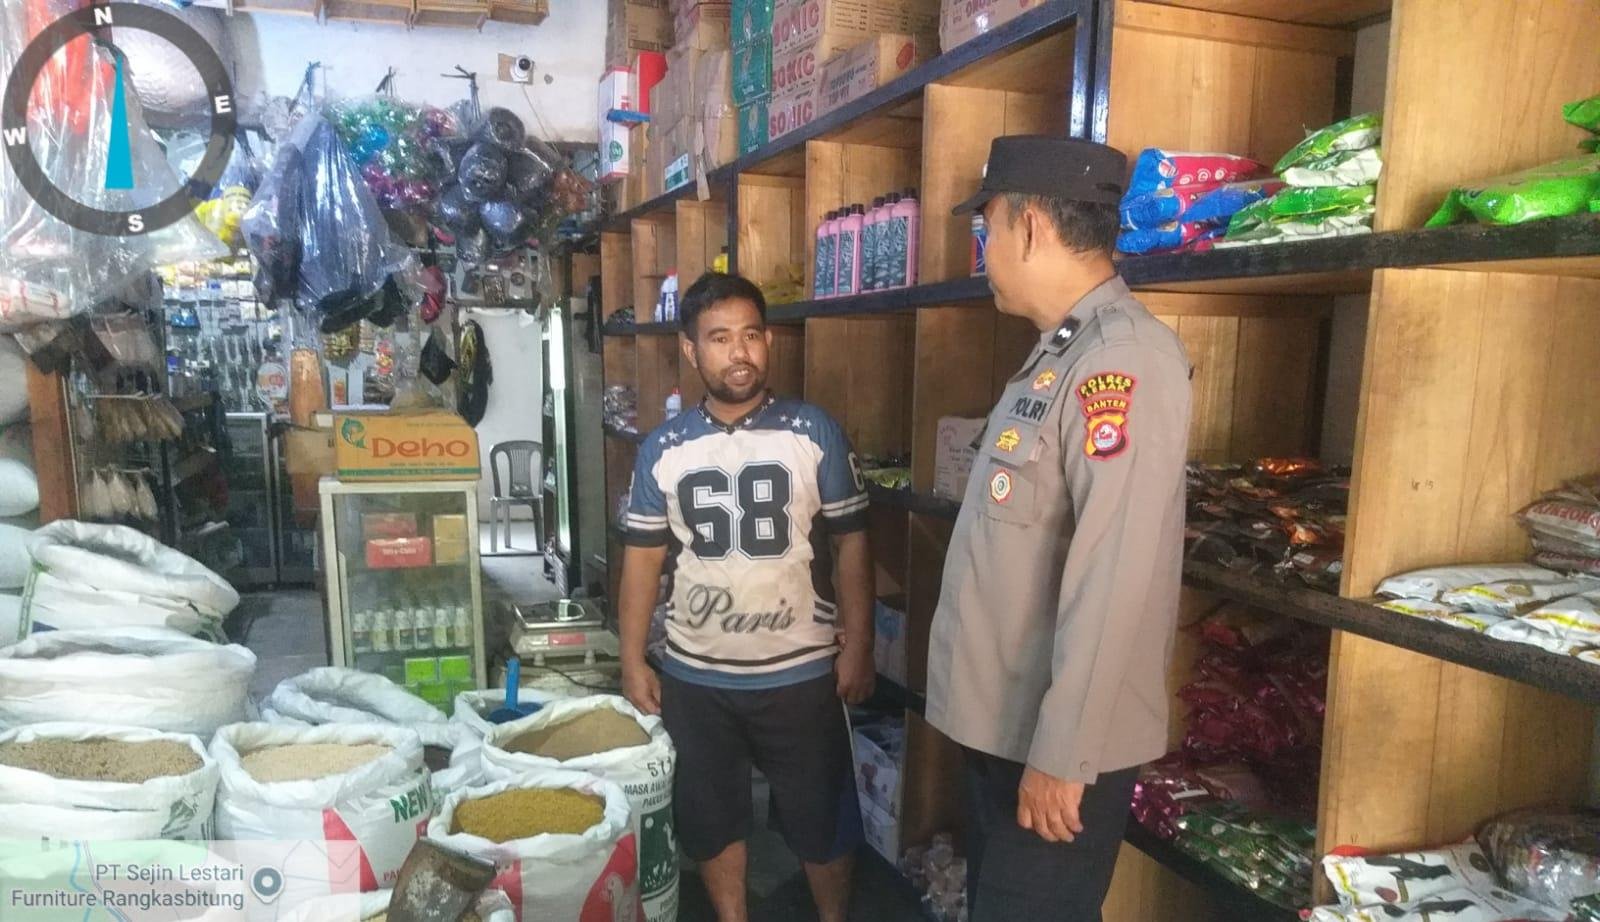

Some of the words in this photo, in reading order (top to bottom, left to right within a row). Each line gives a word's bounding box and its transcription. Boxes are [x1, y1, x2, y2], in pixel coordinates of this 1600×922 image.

[774, 3, 820, 48] SONIC
[771, 52, 816, 92] SONIC
[769, 100, 814, 137] SONIC
[1080, 375, 1132, 394] POLRES
[1086, 399, 1127, 413] BANTEN
[371, 437, 470, 458] Deho
[677, 461, 793, 561] 68
[686, 584, 796, 633] Paris
[624, 783, 649, 796] MASA
